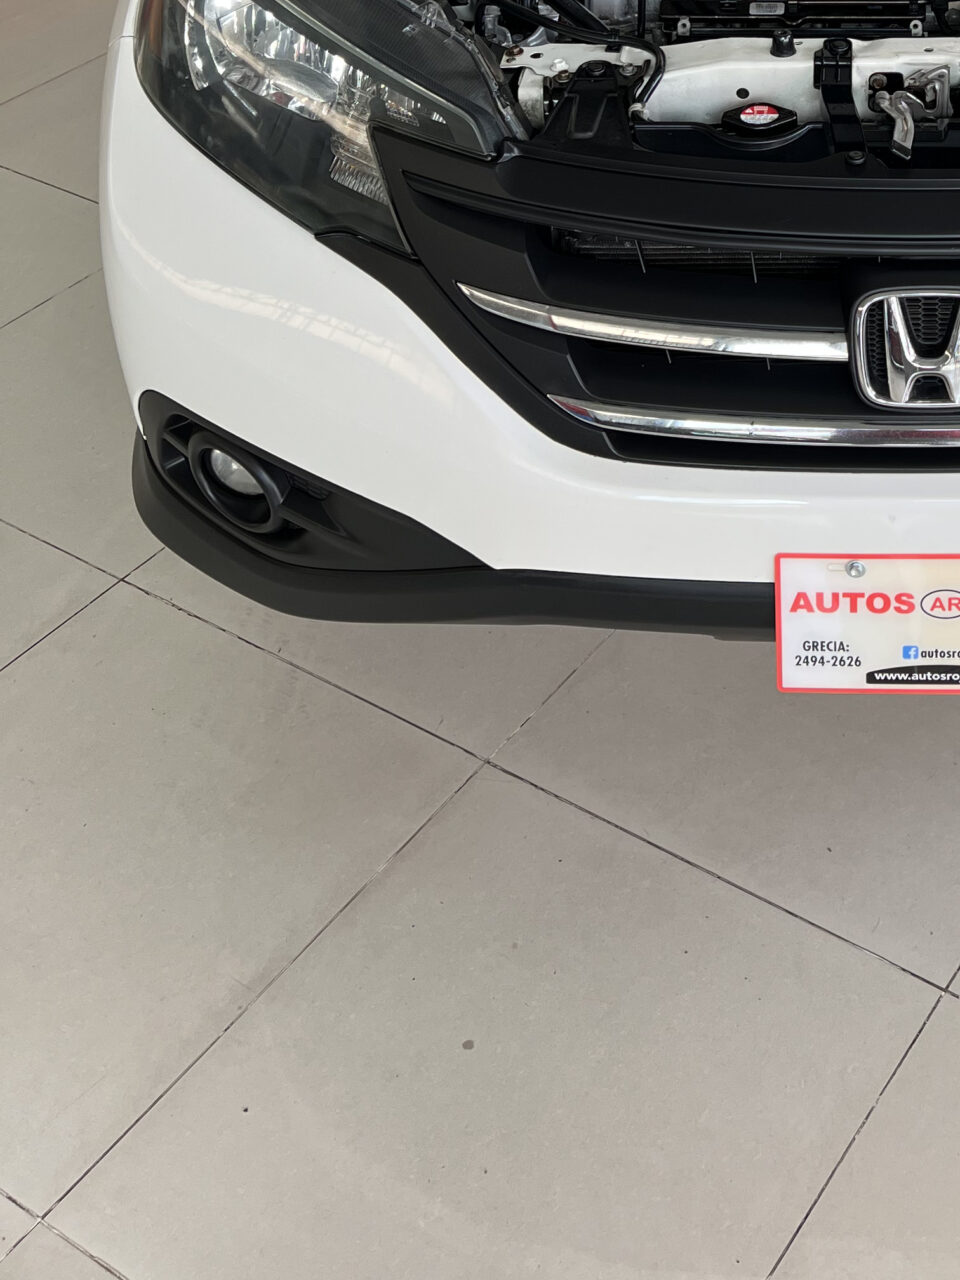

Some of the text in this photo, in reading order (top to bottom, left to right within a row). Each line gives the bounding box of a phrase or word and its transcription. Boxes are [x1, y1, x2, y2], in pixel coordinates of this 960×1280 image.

[789, 591, 916, 614] AUTOS
[802, 640, 850, 652] GRECIA:
[795, 655, 862, 667] 2494-2626
